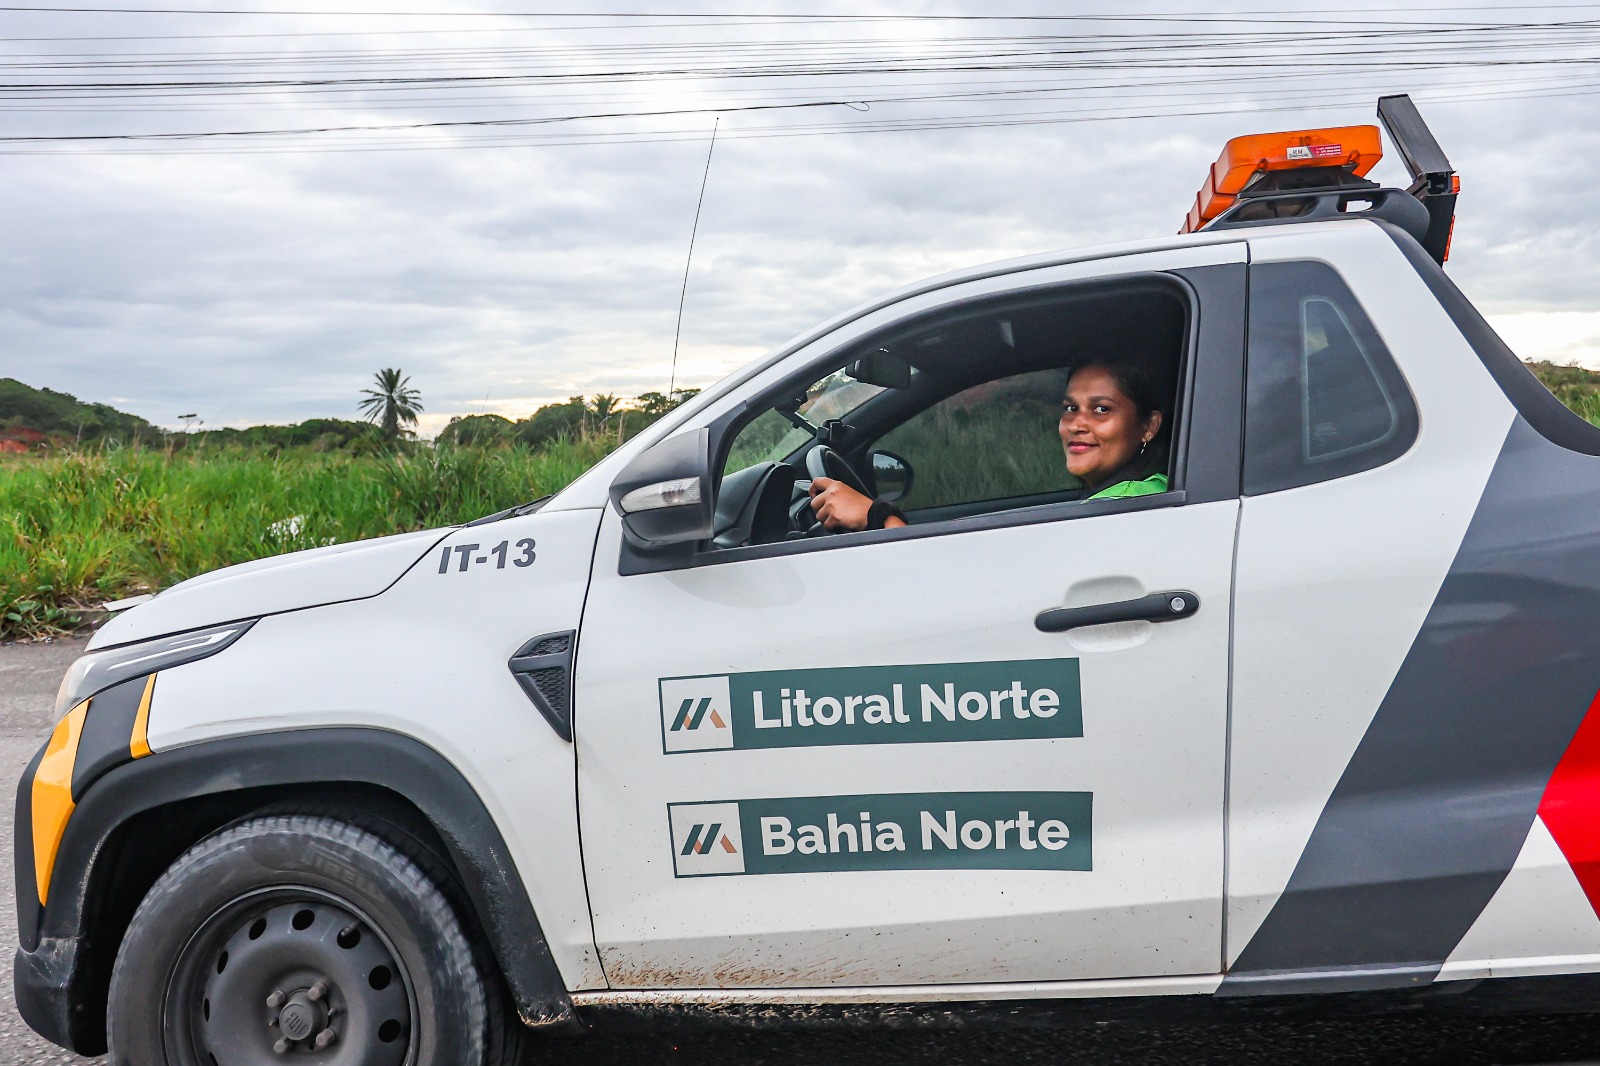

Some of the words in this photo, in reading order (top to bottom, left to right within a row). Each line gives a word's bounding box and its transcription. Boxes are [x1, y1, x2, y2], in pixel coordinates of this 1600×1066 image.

[438, 537, 536, 575] IT-13
[752, 683, 911, 729] Litoral
[920, 680, 1060, 723] Norte
[760, 811, 906, 856] Bahia
[920, 810, 1070, 851] Norte
